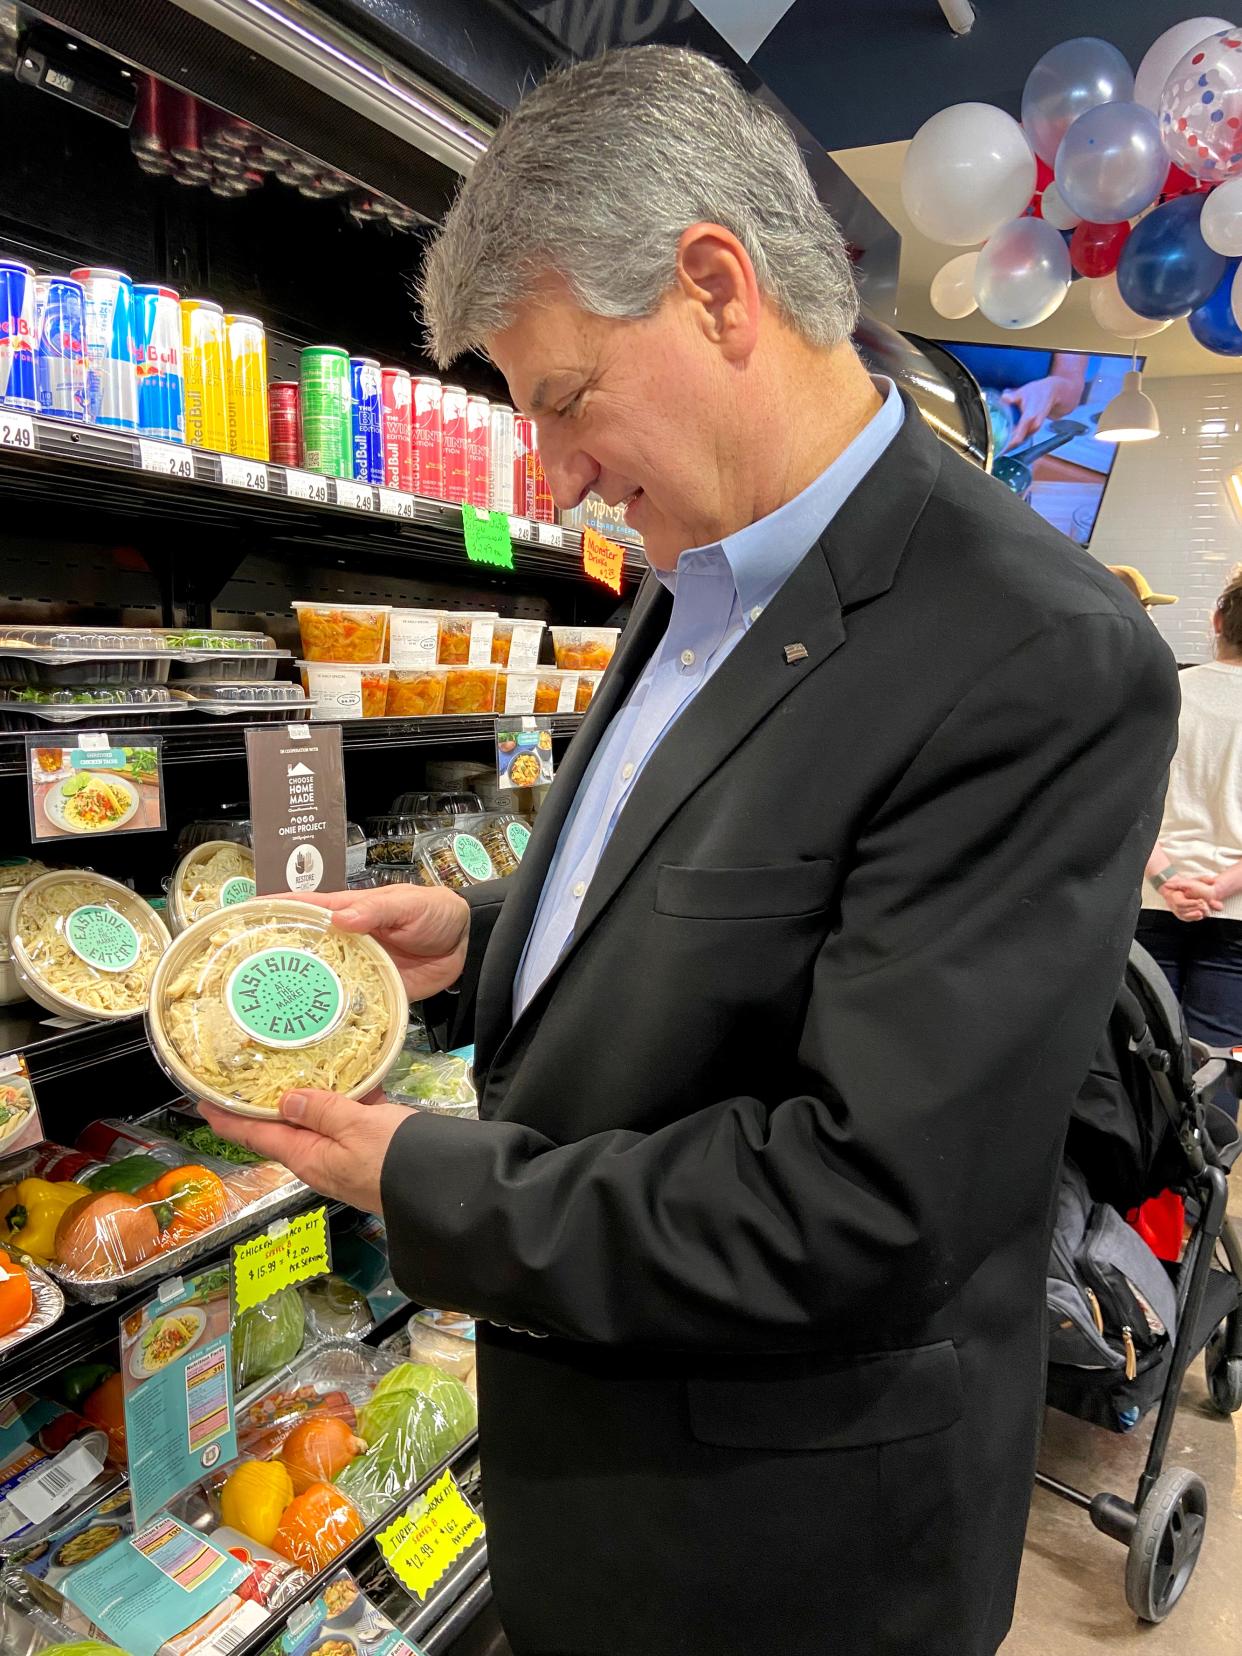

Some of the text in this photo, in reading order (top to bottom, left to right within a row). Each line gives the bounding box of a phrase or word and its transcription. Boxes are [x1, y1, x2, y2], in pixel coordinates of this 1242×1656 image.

[3, 425, 30, 446] 2.49
[354, 435, 367, 480] Red Bull
[170, 458, 191, 477] 2.49
[387, 444, 399, 489] Red Bull
[247, 472, 266, 489] 2.49
[309, 486, 326, 501] 2.49
[356, 495, 371, 510] 2.49
[398, 503, 412, 517] 2.49
[519, 528, 529, 539] 2.49
[551, 534, 560, 546] 2.49
[588, 538, 617, 560] Monster
[587, 550, 608, 567] Drinks
[289, 776, 314, 785] CHOOSE
[289, 783, 314, 794] HOME
[289, 792, 315, 805] MADE
[279, 821, 326, 836] ONIE PROJECT
[295, 873, 315, 885] RESTORE
[226, 881, 256, 905] STSIDE
[74, 911, 126, 940] EASTSIDE
[89, 940, 133, 963] EATERY
[238, 956, 315, 1013] EASTSIDE
[274, 981, 285, 991] AT
[278, 985, 293, 998] THE
[275, 986, 306, 1010] MARKET
[269, 988, 331, 1034] EATERY
[240, 1240, 273, 1260] CHICKEN
[305, 1218, 320, 1230] KIT
[289, 1262, 301, 1272] PER
[186, 1355, 209, 1371] Nutrition
[209, 1348, 225, 1360] Facts
[213, 1362, 226, 1374] 310
[132, 1519, 171, 1545] Nutrition Facts
[389, 1521, 418, 1548] TURKEY
[405, 1543, 435, 1569] $12.99
[391, 1641, 405, 1656] Facts
